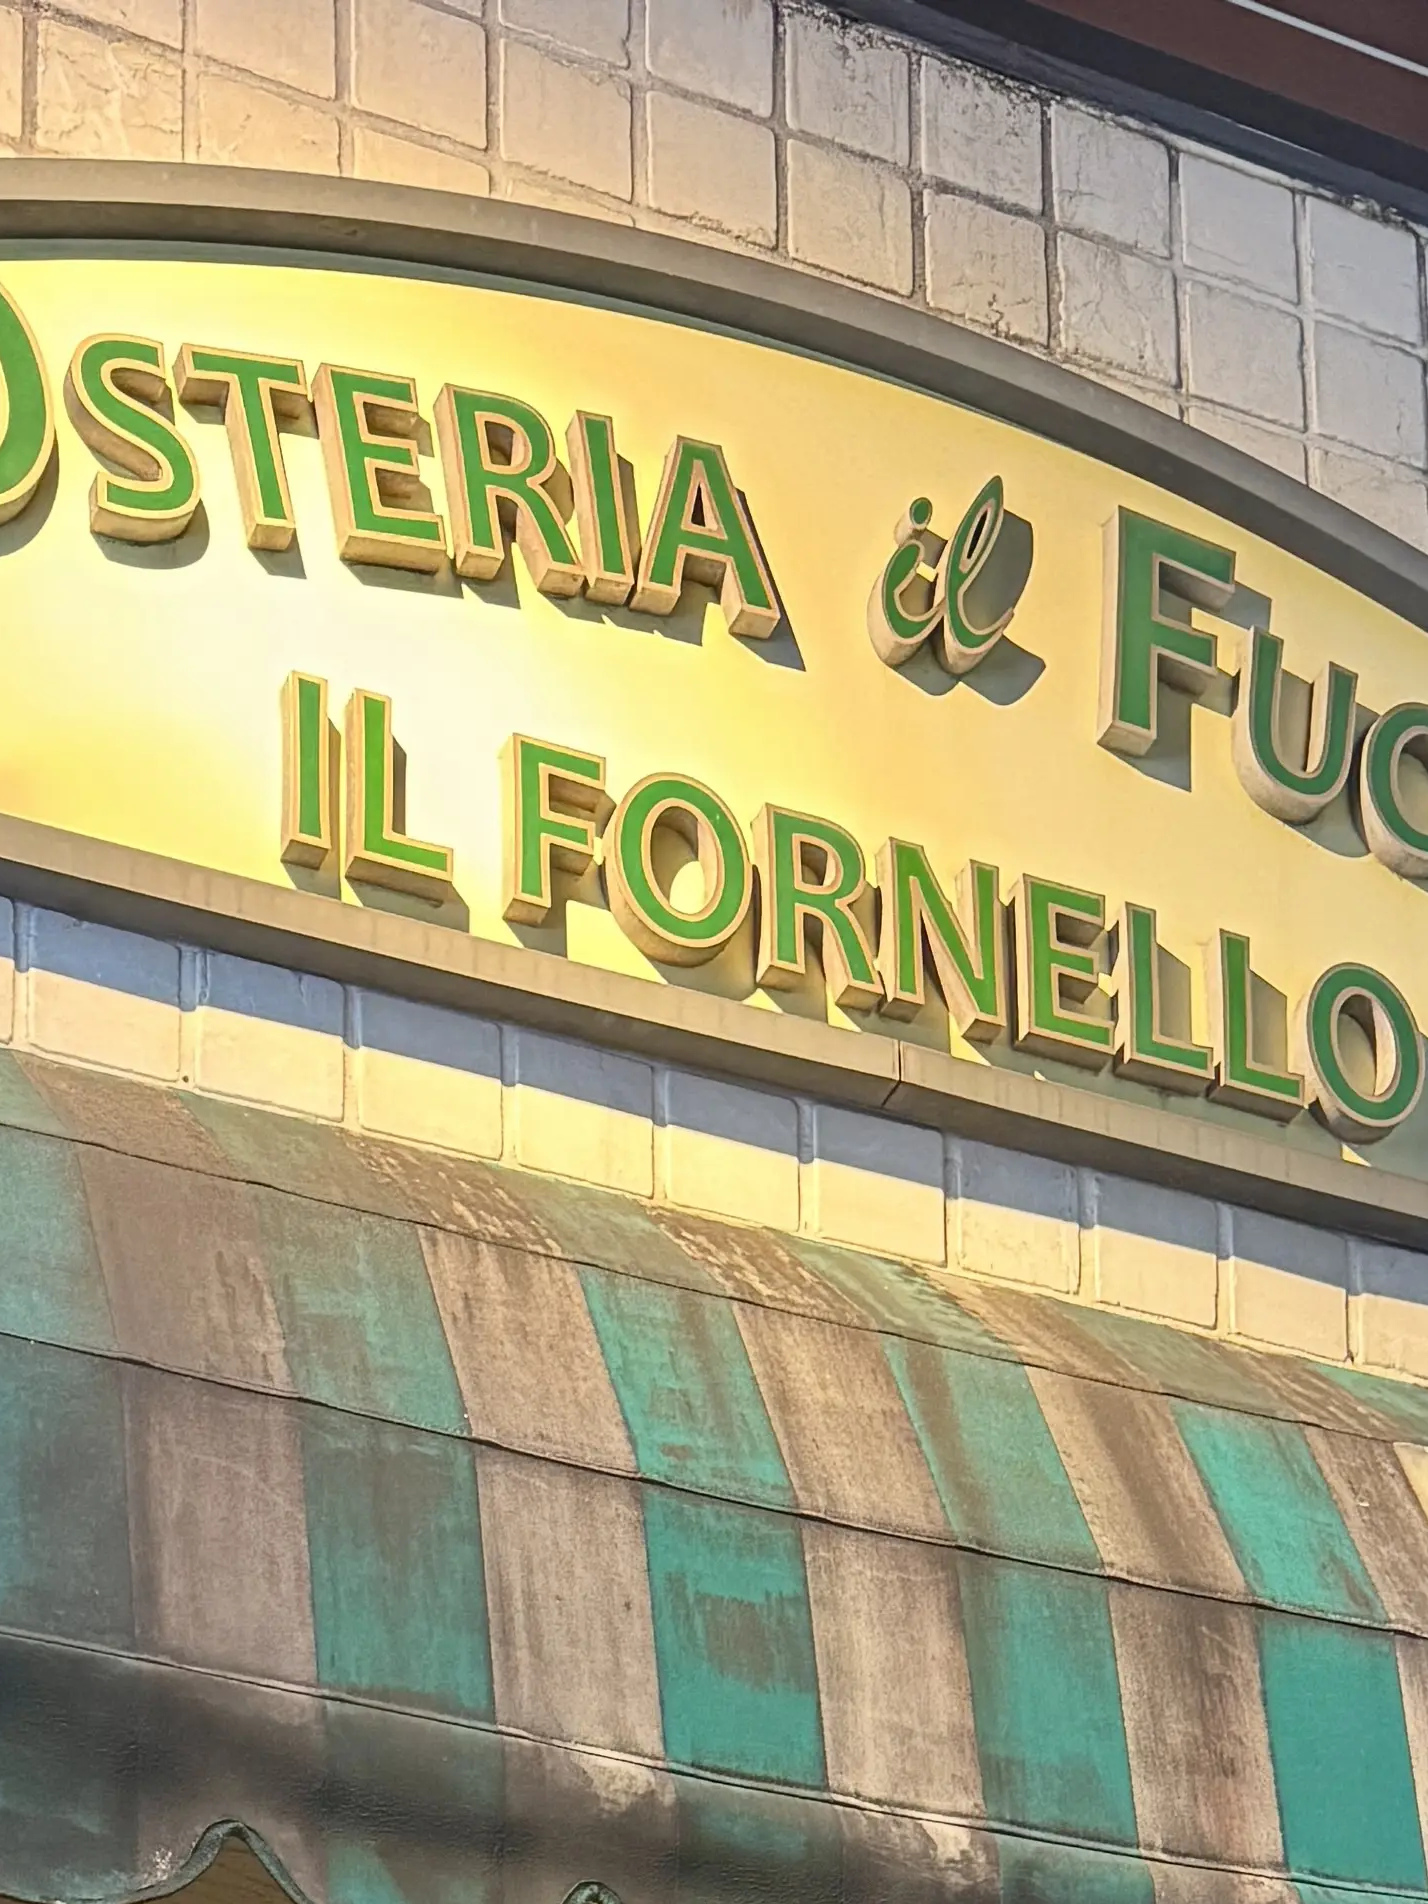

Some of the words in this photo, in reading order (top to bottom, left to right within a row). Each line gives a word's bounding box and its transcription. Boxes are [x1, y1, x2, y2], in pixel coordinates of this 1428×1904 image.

[867, 474, 1014, 675] il
[280, 669, 454, 907] IL
[501, 731, 1427, 1145] FORNELLO
